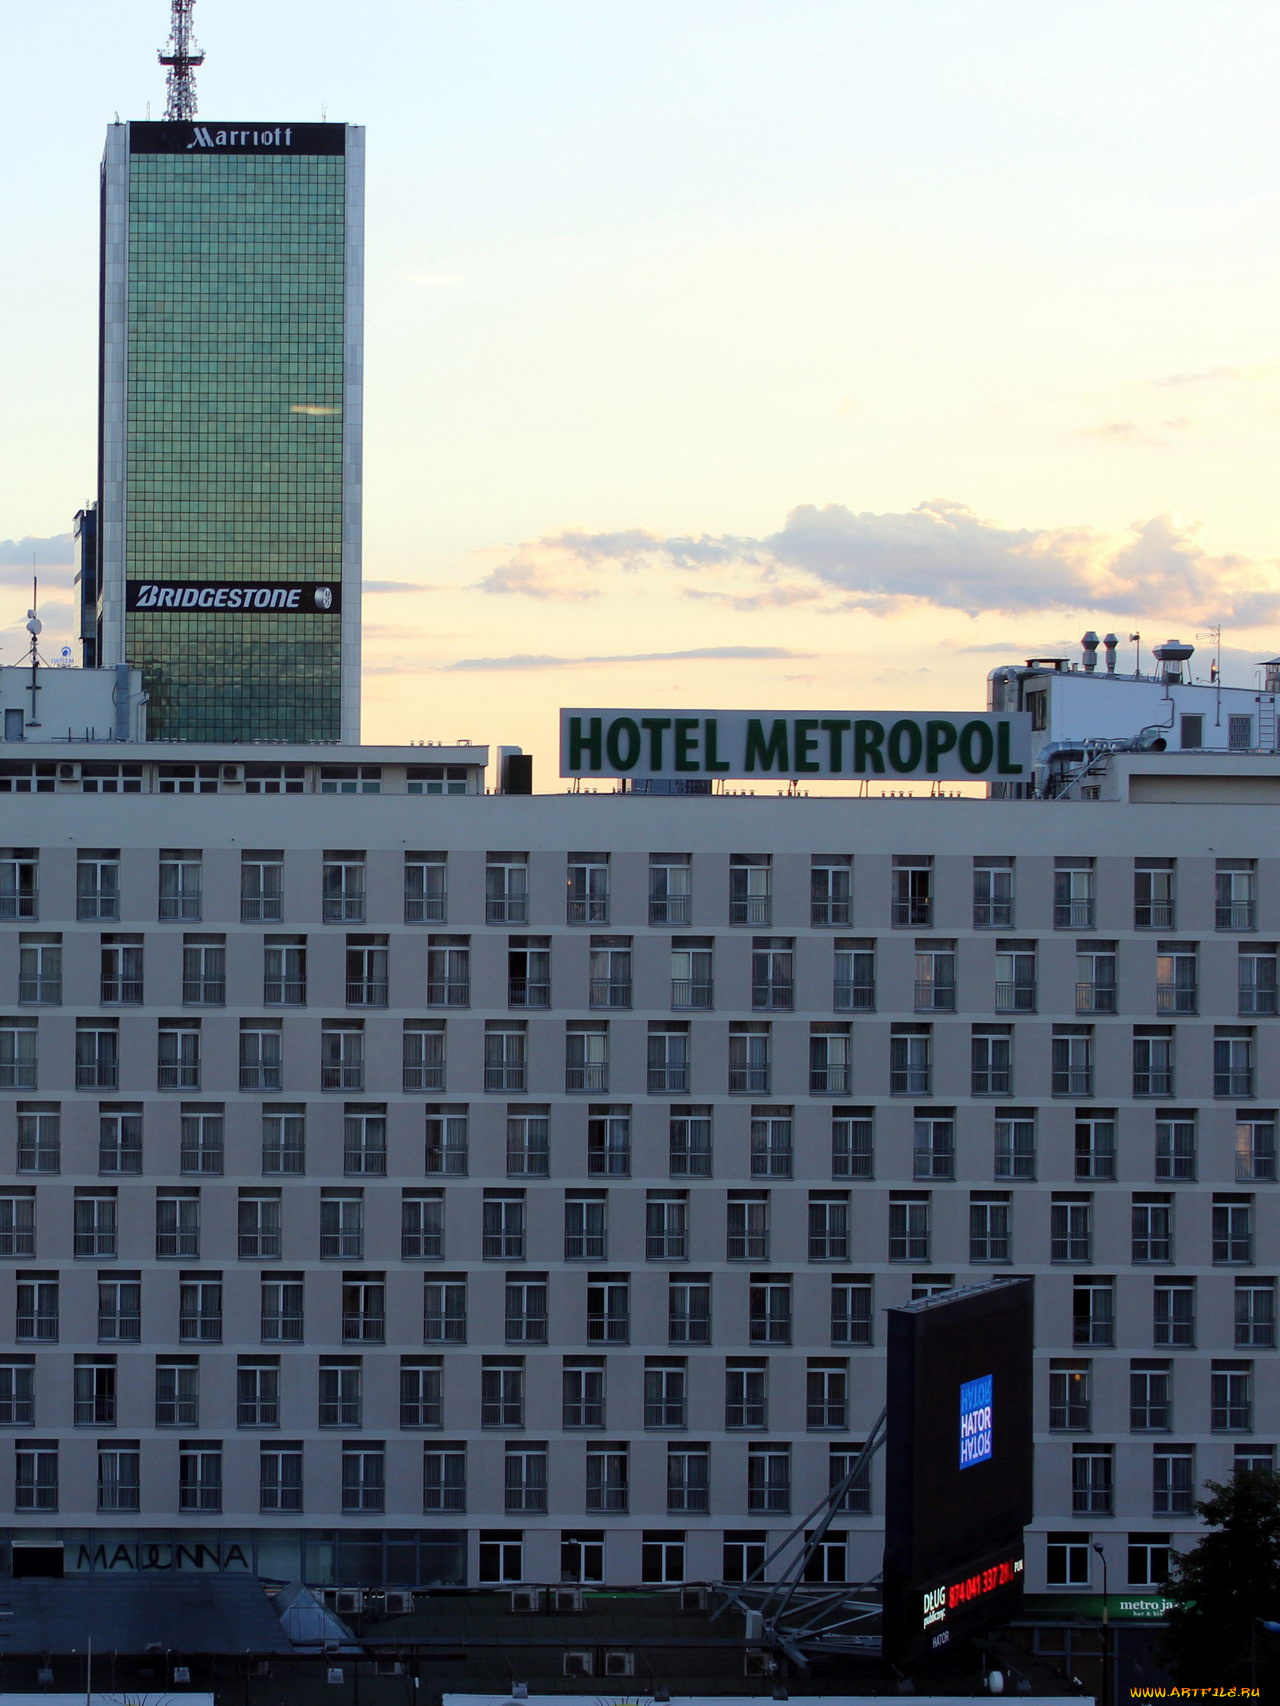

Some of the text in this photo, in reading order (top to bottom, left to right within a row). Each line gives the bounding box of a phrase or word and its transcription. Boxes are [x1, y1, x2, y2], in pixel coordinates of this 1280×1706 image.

[187, 126, 292, 148] Marriott
[136, 585, 302, 608] BRIDGESTONE
[569, 717, 1023, 774] HOTEL METROPOL
[961, 1406, 991, 1438] HATOR
[77, 1543, 248, 1569] MADONNA
[923, 1586, 946, 1614] DŁUG
[949, 1582, 965, 1608] 874
[982, 1566, 998, 1592] 337
[1120, 1600, 1159, 1610] metro
